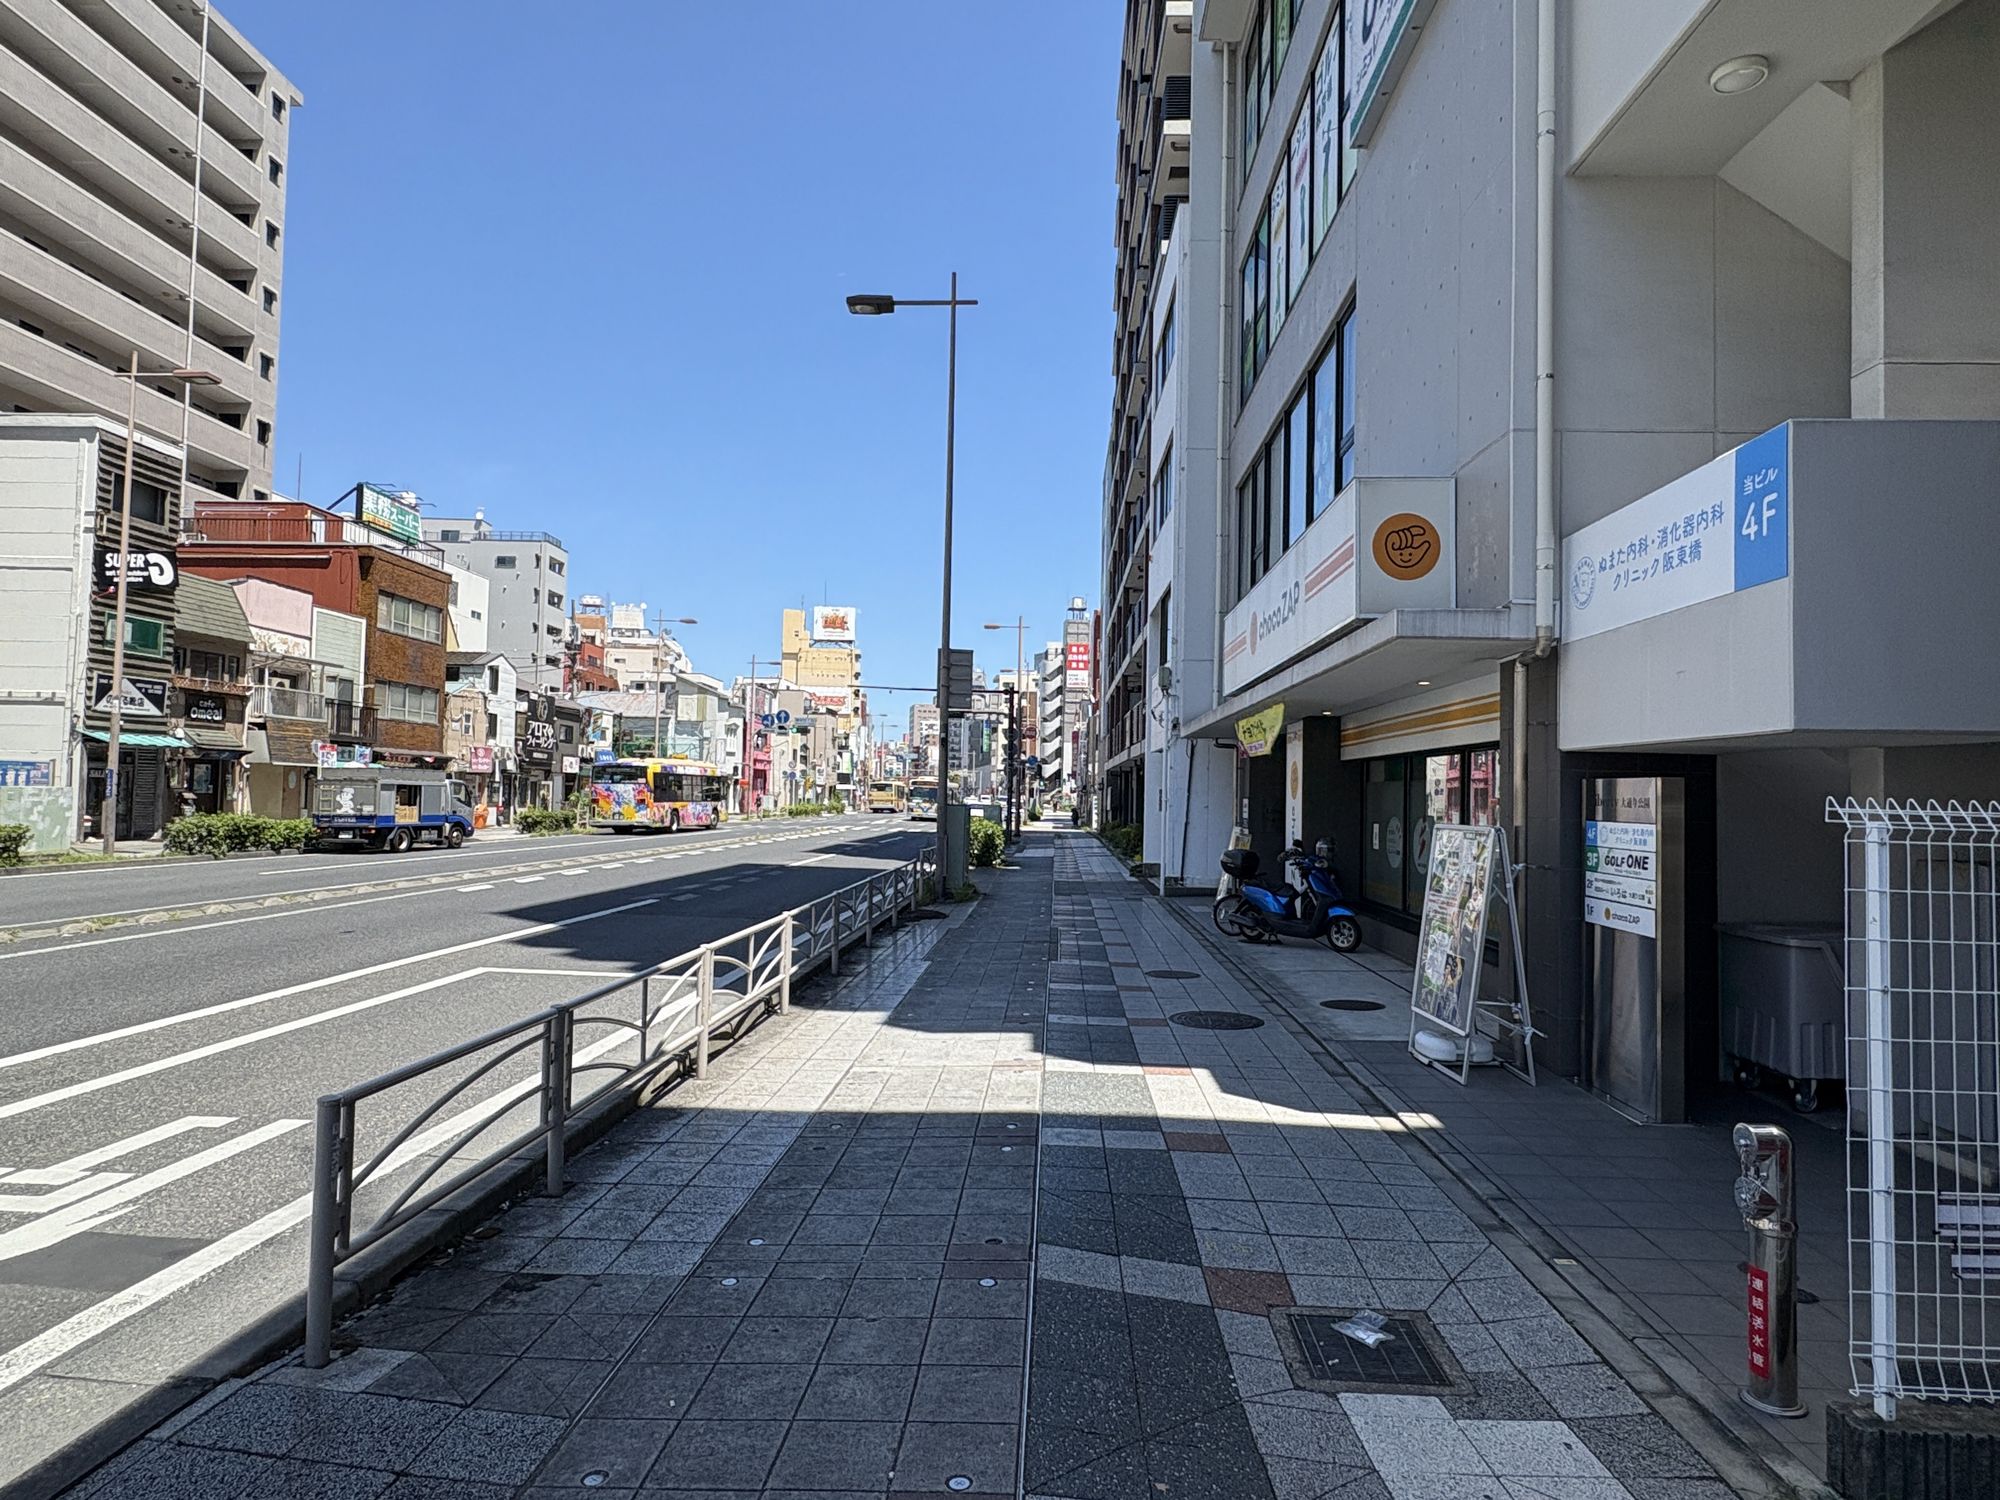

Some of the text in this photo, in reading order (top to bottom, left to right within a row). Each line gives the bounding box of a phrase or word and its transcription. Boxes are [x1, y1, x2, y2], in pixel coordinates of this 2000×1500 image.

[1743, 467, 1779, 496] 当ビル
[363, 490, 419, 528] 業務スーパー
[1741, 492, 1778, 542] 4F
[1598, 501, 1726, 574] ぬまた内科・消化器内科
[1258, 580, 1300, 641] chocoZAP
[199, 699, 216, 708] cafe
[527, 721, 549, 737] アロマ
[526, 735, 557, 749] フィーリング
[1587, 827, 1596, 839] 4F
[1586, 852, 1598, 867] 3F
[1604, 854, 1650, 871] GOLF ONE
[1586, 878, 1594, 889] 2F
[1586, 904, 1594, 916] 1F
[1751, 1275, 1764, 1368] 連結送水管
